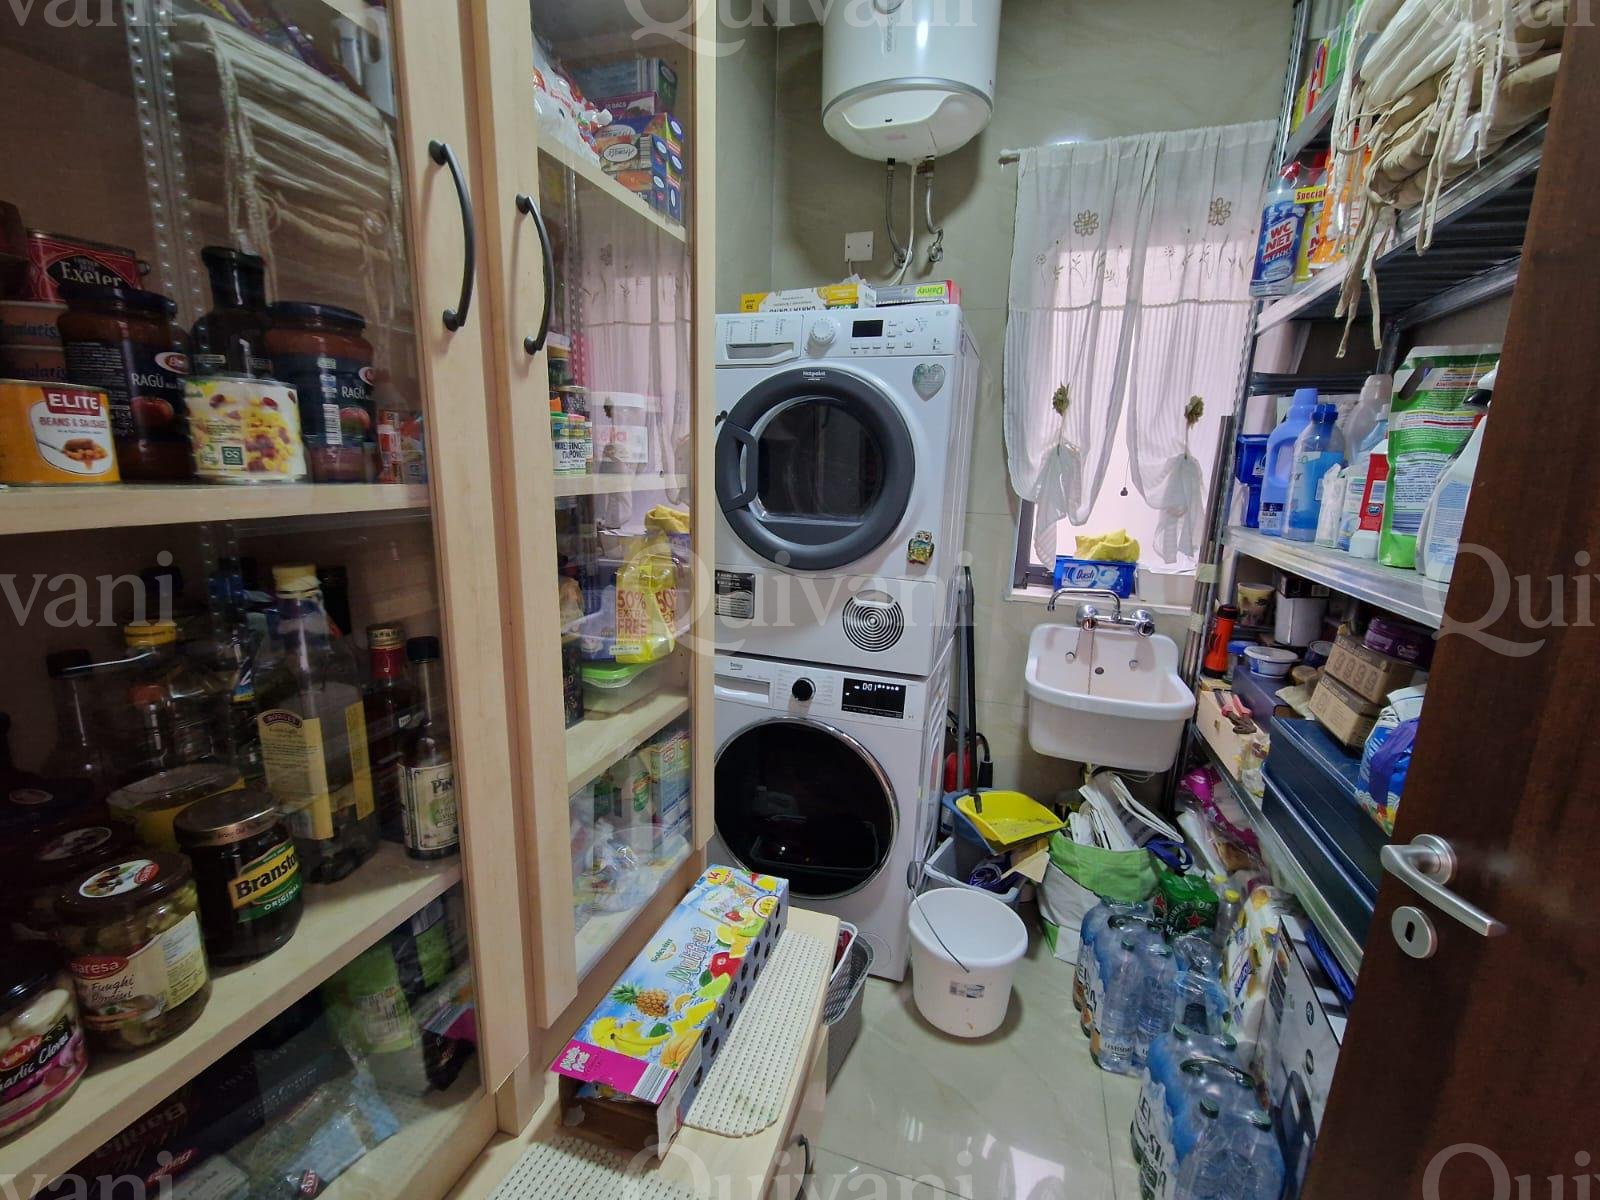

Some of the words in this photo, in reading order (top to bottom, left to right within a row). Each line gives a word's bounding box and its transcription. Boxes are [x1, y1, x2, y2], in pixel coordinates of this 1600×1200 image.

[1270, 221, 1292, 239] WC
[1265, 232, 1292, 253] NET
[47, 393, 100, 410] ELITE
[235, 853, 297, 900] Bransto
[0, 1062, 35, 1090] arlic
